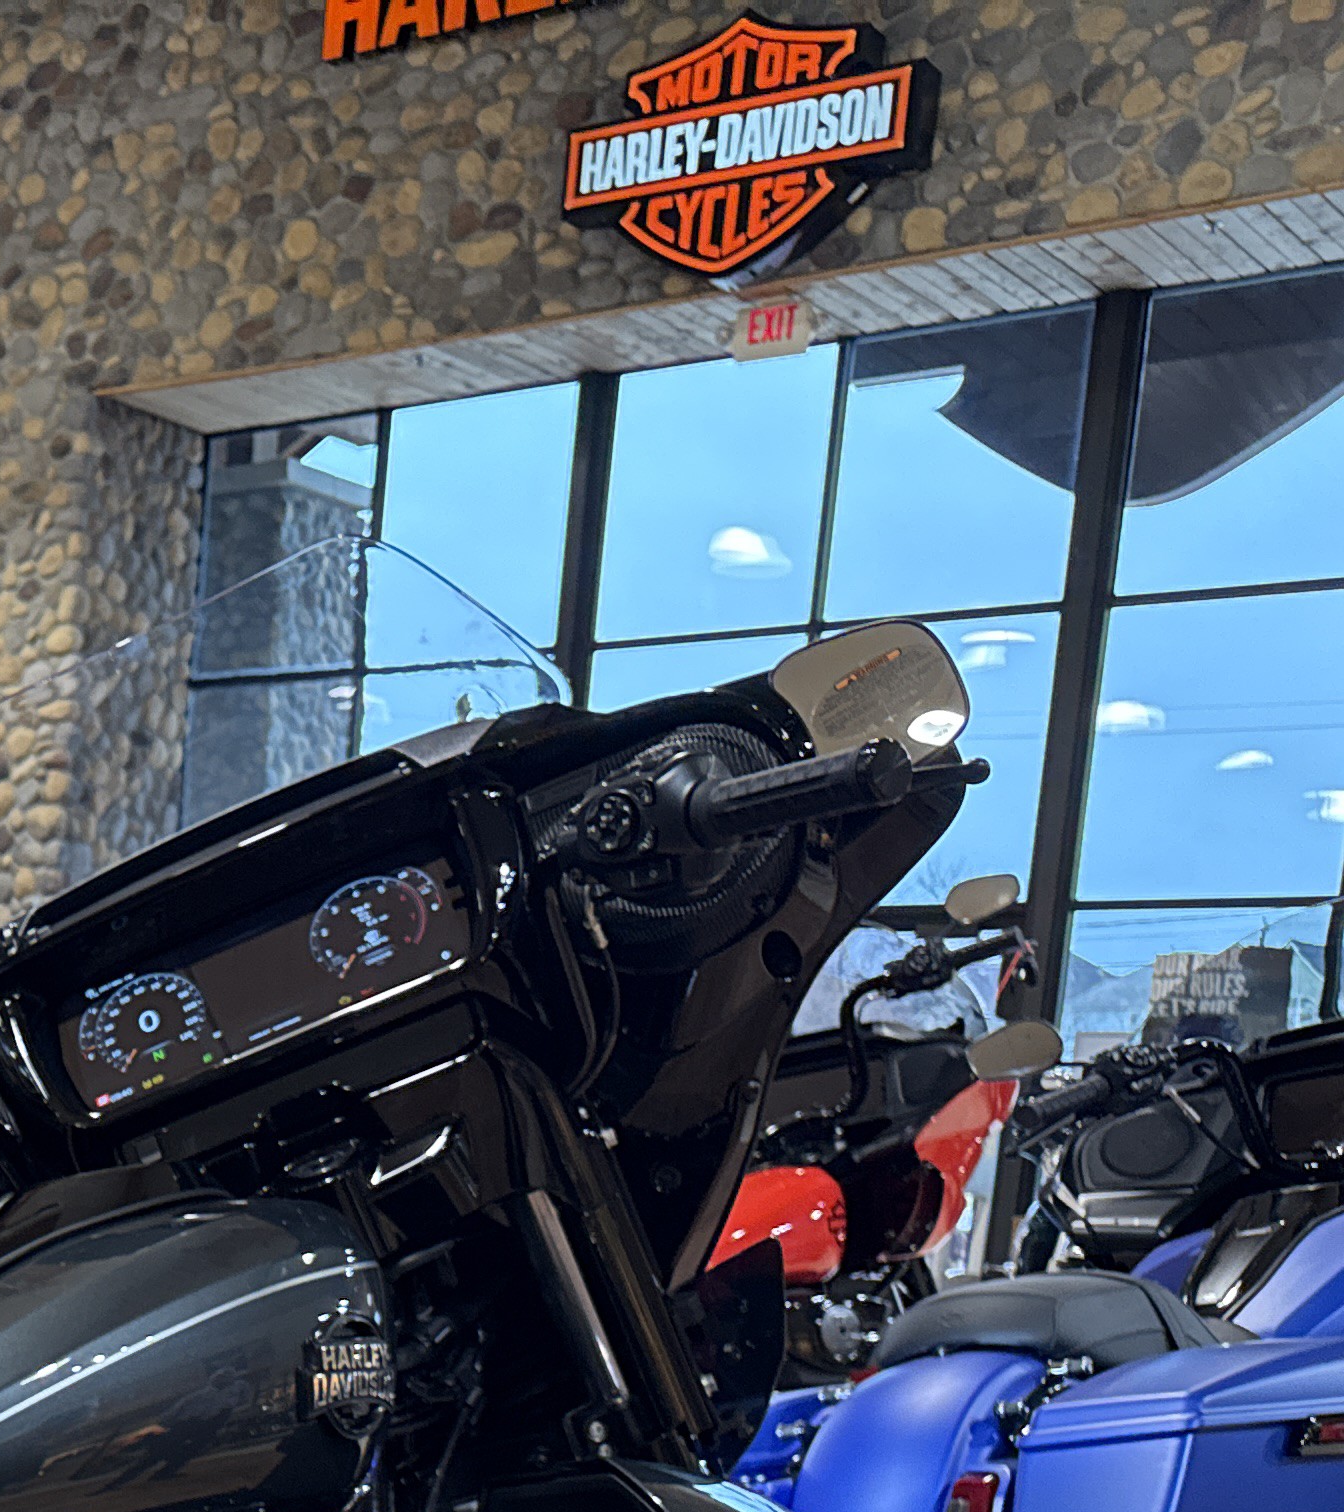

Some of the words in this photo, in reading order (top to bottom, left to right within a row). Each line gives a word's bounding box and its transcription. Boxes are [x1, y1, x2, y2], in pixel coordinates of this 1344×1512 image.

[655, 34, 822, 112] MOTOR
[579, 82, 895, 195] HARLEY-DAVIDSON
[646, 170, 808, 259] CYCLES
[747, 303, 799, 346] EXIT
[138, 1010, 161, 1034] 0
[320, 1343, 391, 1372] HARLEY
